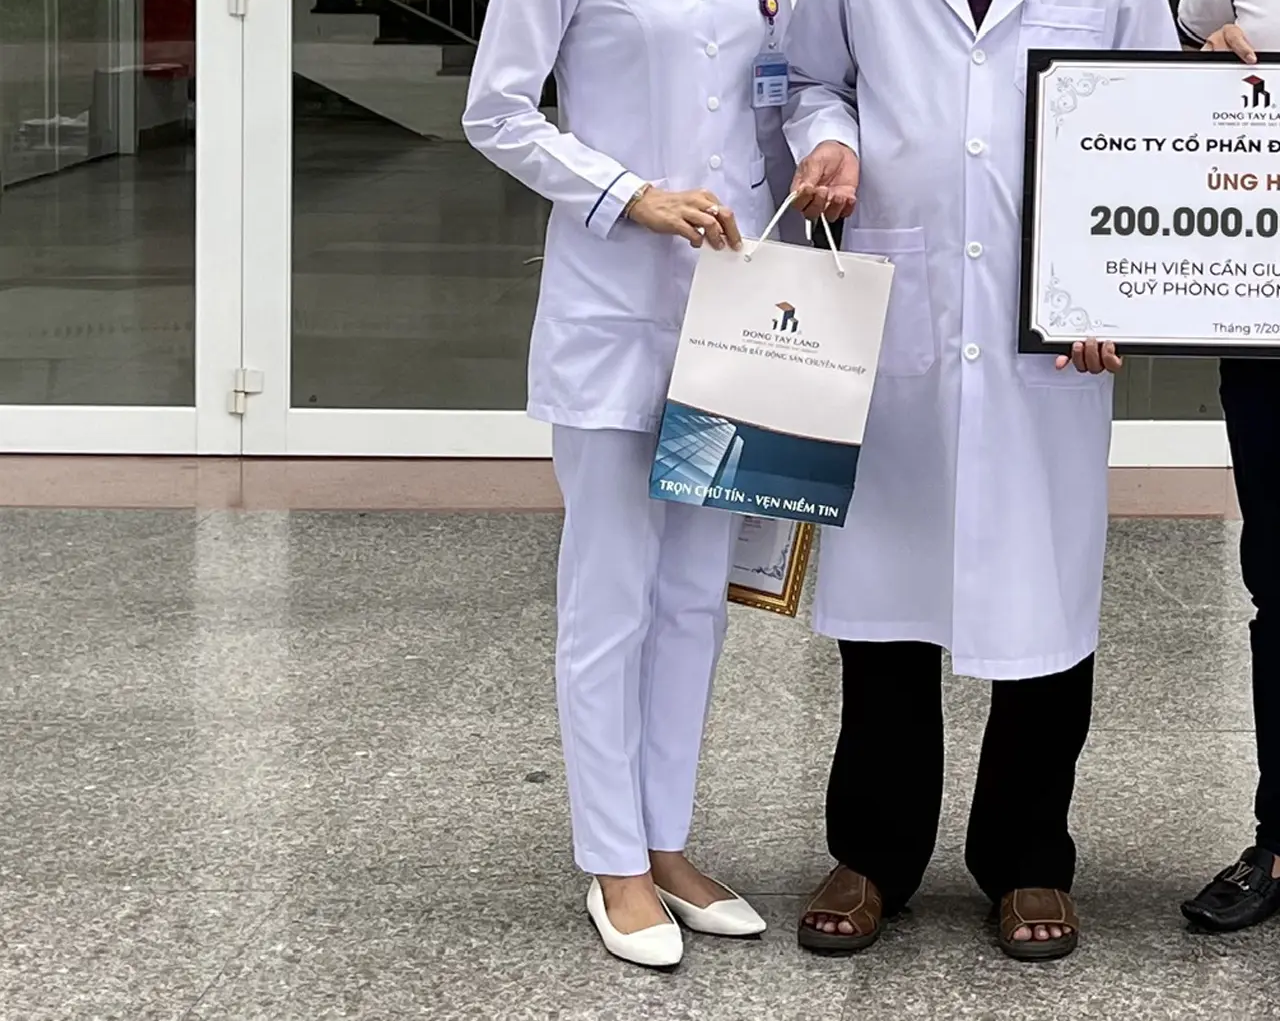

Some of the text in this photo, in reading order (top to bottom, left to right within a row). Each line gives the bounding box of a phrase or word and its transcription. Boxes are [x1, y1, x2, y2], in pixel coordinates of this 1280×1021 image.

[1212, 112, 1245, 120] DONG
[1248, 112, 1267, 120] TAY
[1080, 133, 1137, 152] CÔNG
[1142, 137, 1167, 152] TY
[1172, 133, 1200, 152] CỔ
[1207, 166, 1259, 191] ỦNG
[1106, 258, 1157, 277] BỆNH
[1162, 259, 1204, 278] VIỆN
[1119, 279, 1158, 299] QUỸ
[1163, 279, 1229, 297] PHÒNG
[742, 329, 772, 341] DONG
[774, 334, 791, 344] TAY
[793, 338, 820, 349] LAND
[1212, 322, 1251, 336] Tháng
[659, 479, 692, 496] TRỌN
[694, 485, 722, 499] CHỮ
[724, 487, 745, 503] TÍN
[755, 494, 780, 510] VẸN
[818, 504, 839, 518] TIN
